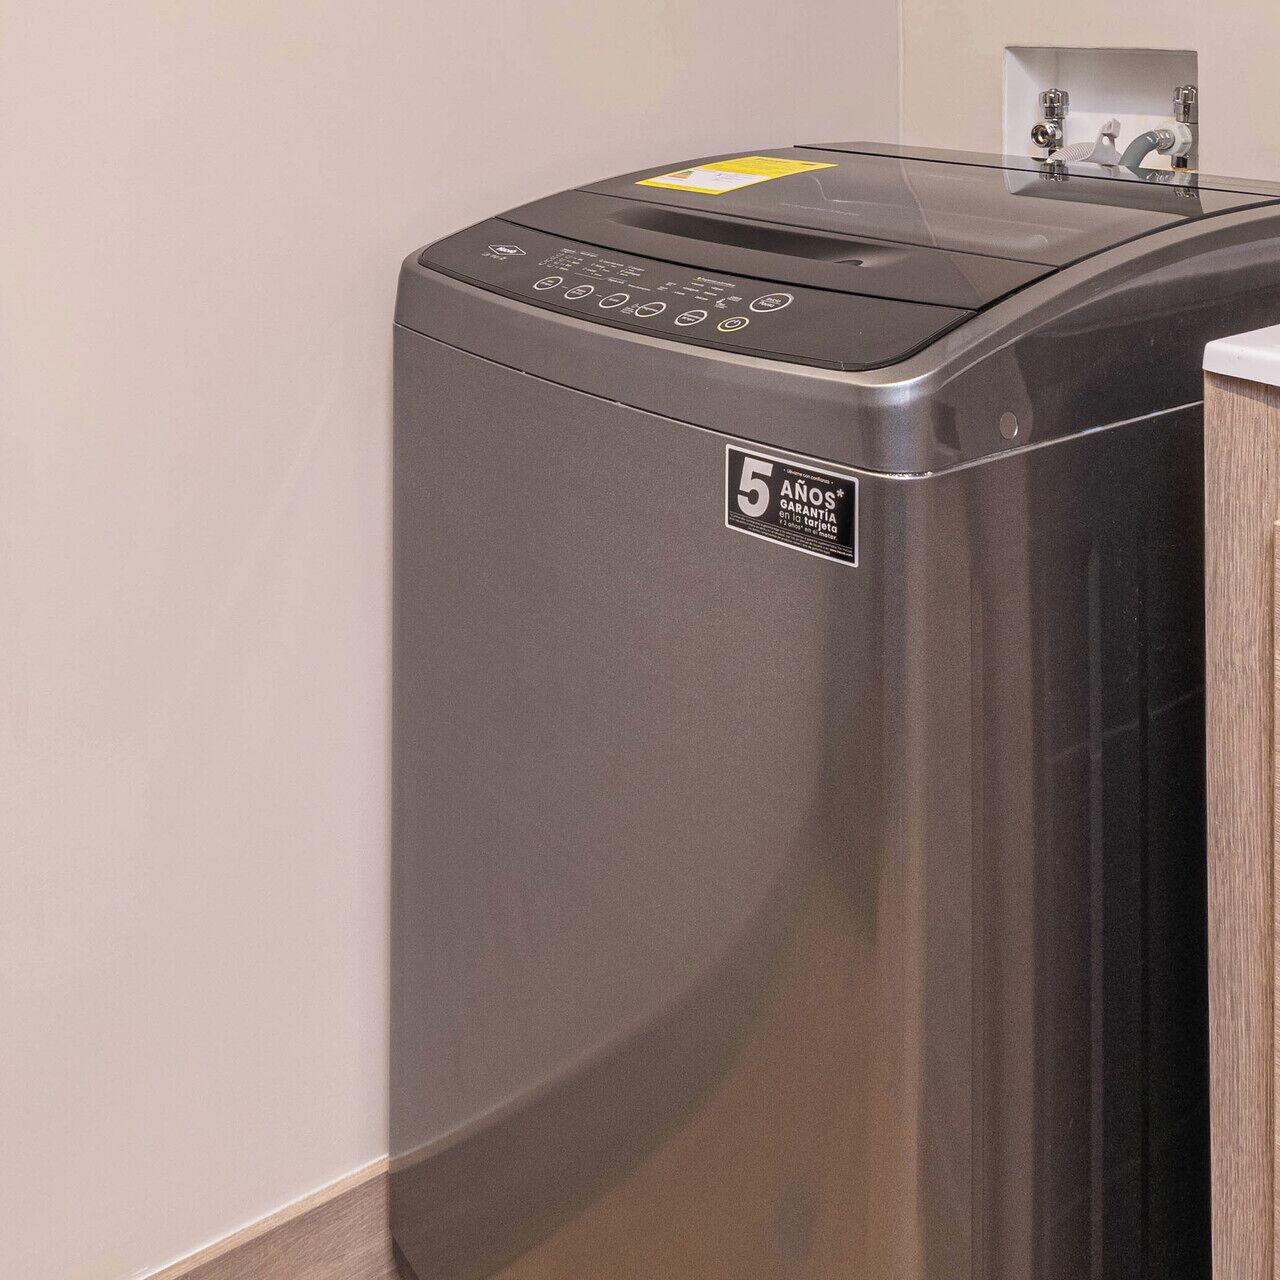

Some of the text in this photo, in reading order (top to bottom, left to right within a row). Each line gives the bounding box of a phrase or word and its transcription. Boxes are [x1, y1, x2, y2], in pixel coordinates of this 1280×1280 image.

[737, 456, 773, 517] 5
[779, 510, 837, 533] en la tarjeta
[780, 499, 836, 523] GARANTÍA
[818, 530, 836, 540] motor.
